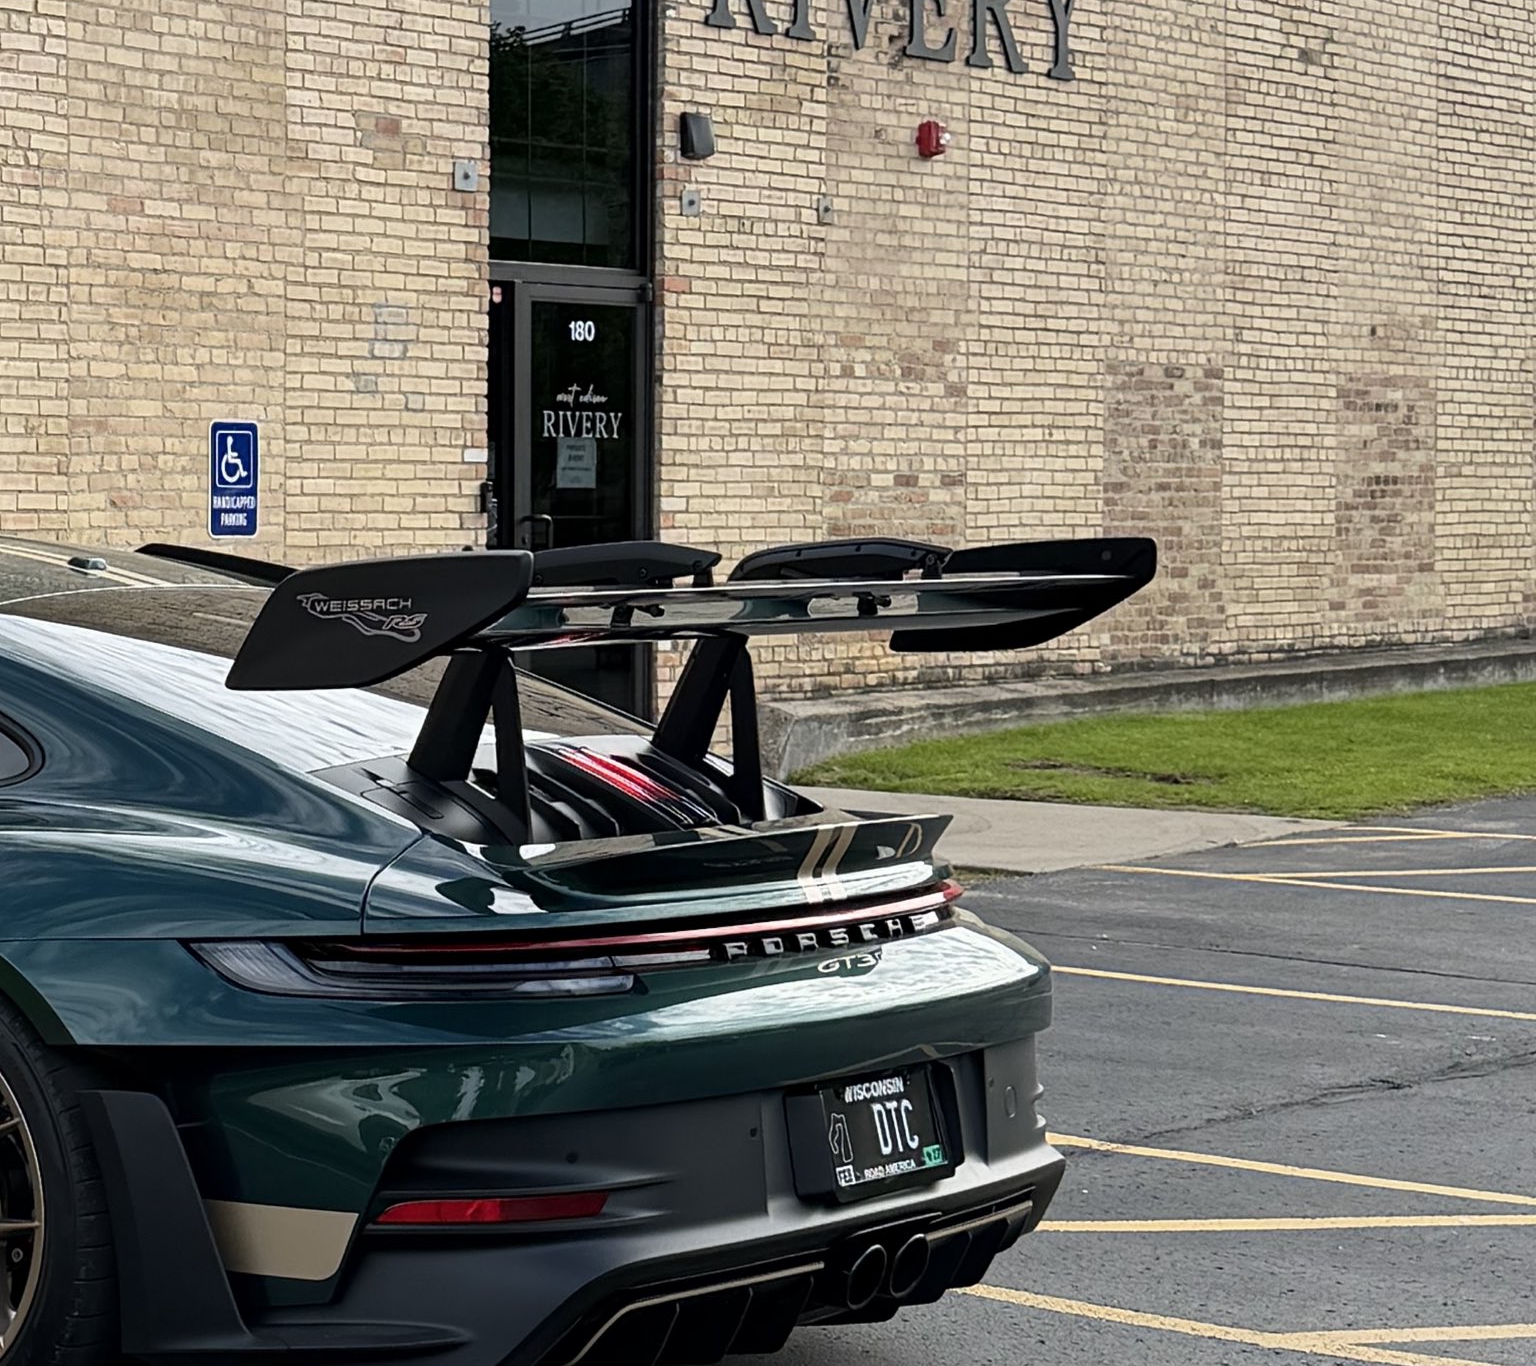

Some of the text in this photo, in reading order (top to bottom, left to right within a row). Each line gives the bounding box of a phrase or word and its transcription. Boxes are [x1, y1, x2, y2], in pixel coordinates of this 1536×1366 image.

[568, 321, 595, 342] 180
[542, 410, 623, 439] RIVERY
[213, 496, 256, 509] HANDICAPPED
[220, 512, 248, 526] PARKING
[314, 598, 412, 613] WEISSACH
[723, 911, 939, 960] PORSCHE
[844, 1076, 904, 1103] WISCONSIN
[871, 1099, 919, 1155] DTC
[885, 1159, 916, 1174] AMERICA
